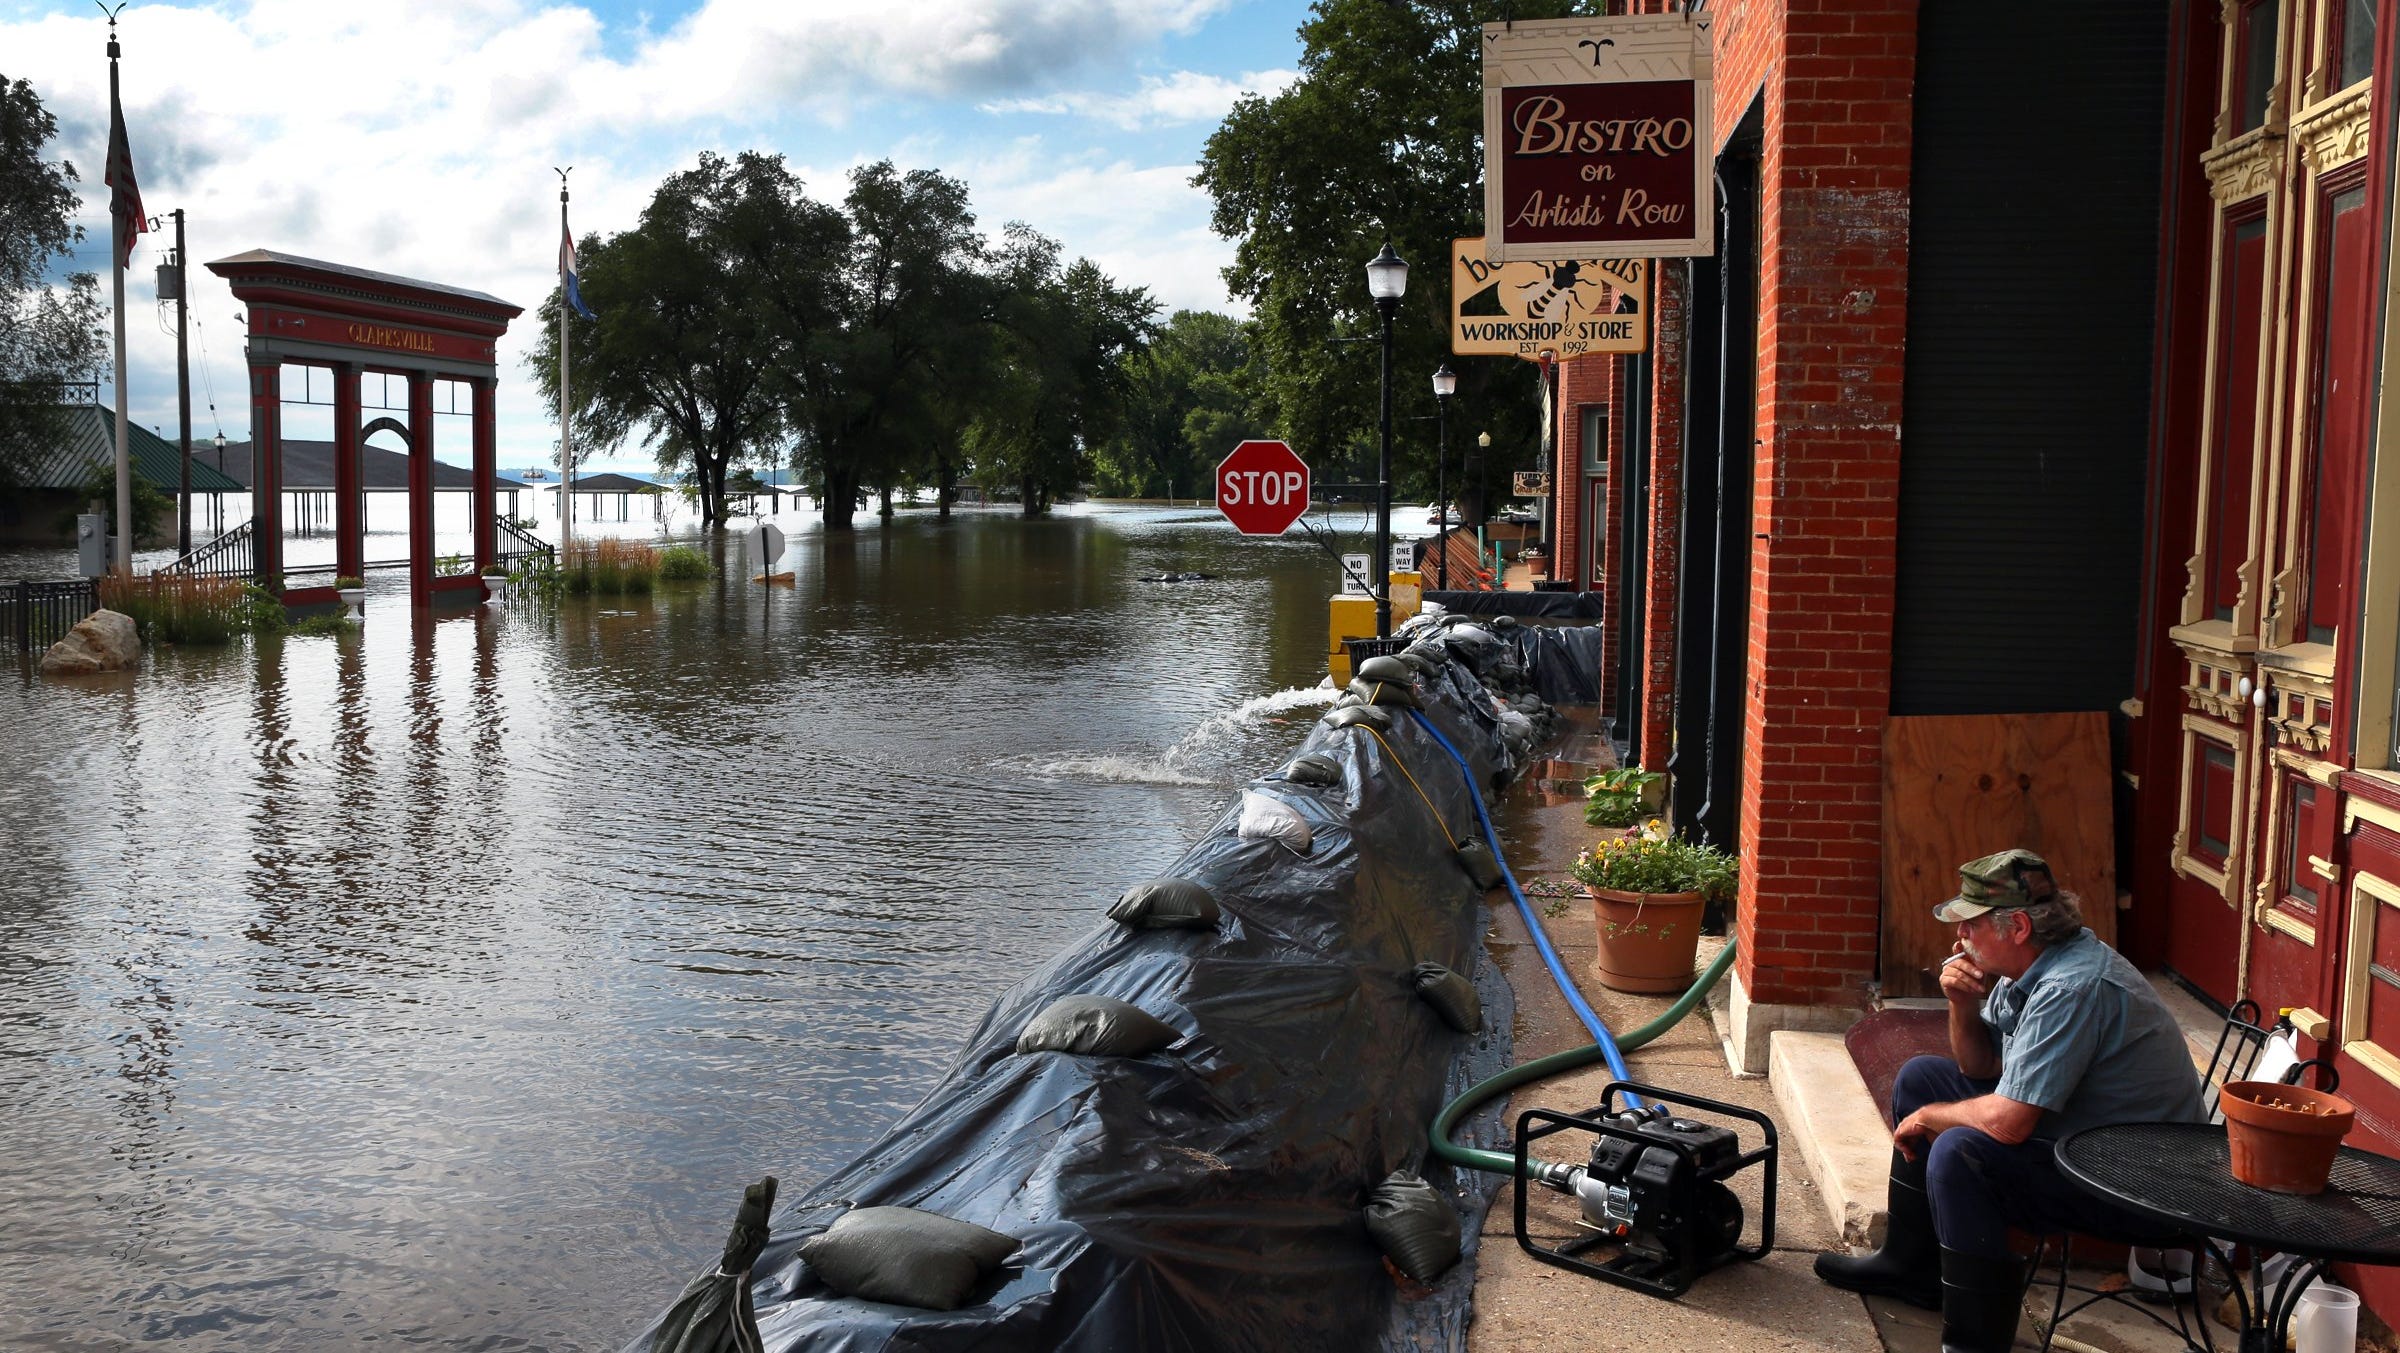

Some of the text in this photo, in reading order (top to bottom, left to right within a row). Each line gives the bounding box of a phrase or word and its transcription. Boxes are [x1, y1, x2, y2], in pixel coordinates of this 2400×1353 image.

[1580, 164, 1616, 182] on
[1616, 188, 1685, 228] Row
[348, 324, 436, 352] CLARKSVILLE
[1460, 321, 1633, 341] WORKSHOP & STORE
[1519, 341, 1588, 353] EST 1992
[1223, 471, 1303, 505] STOP
[1396, 547, 1411, 555] ONE
[1350, 560, 1362, 569] NO
[1395, 558, 1411, 566] WAY
